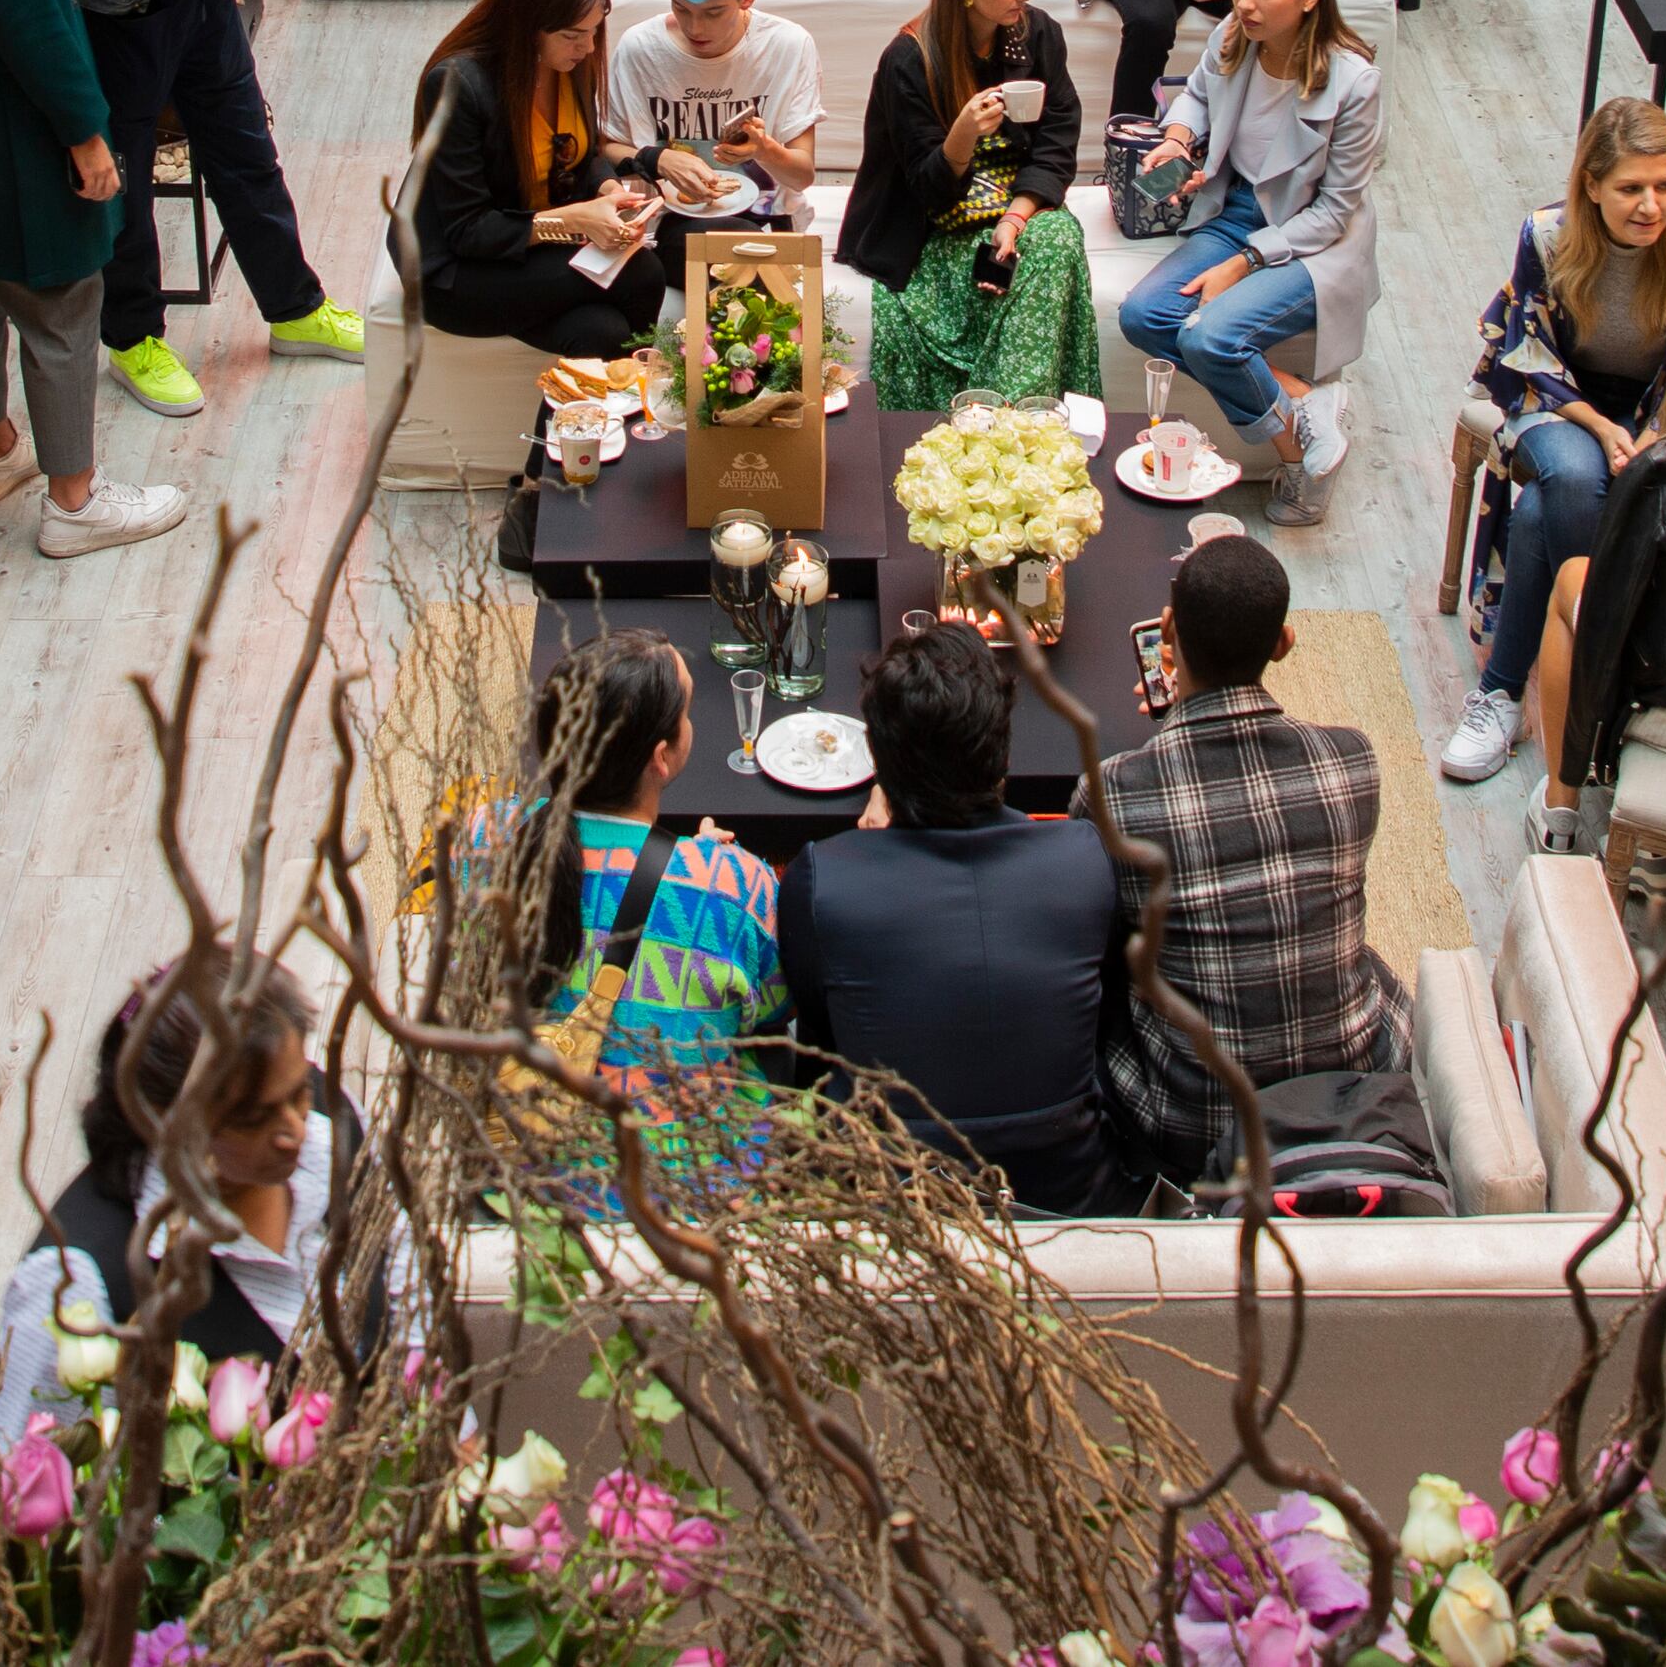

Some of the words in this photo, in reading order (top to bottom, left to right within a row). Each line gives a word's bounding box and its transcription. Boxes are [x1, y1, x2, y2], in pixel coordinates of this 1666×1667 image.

[683, 87, 733, 101] Sleeping
[723, 470, 779, 480] ADRIANA
[718, 478, 783, 490] SATIZABAL
